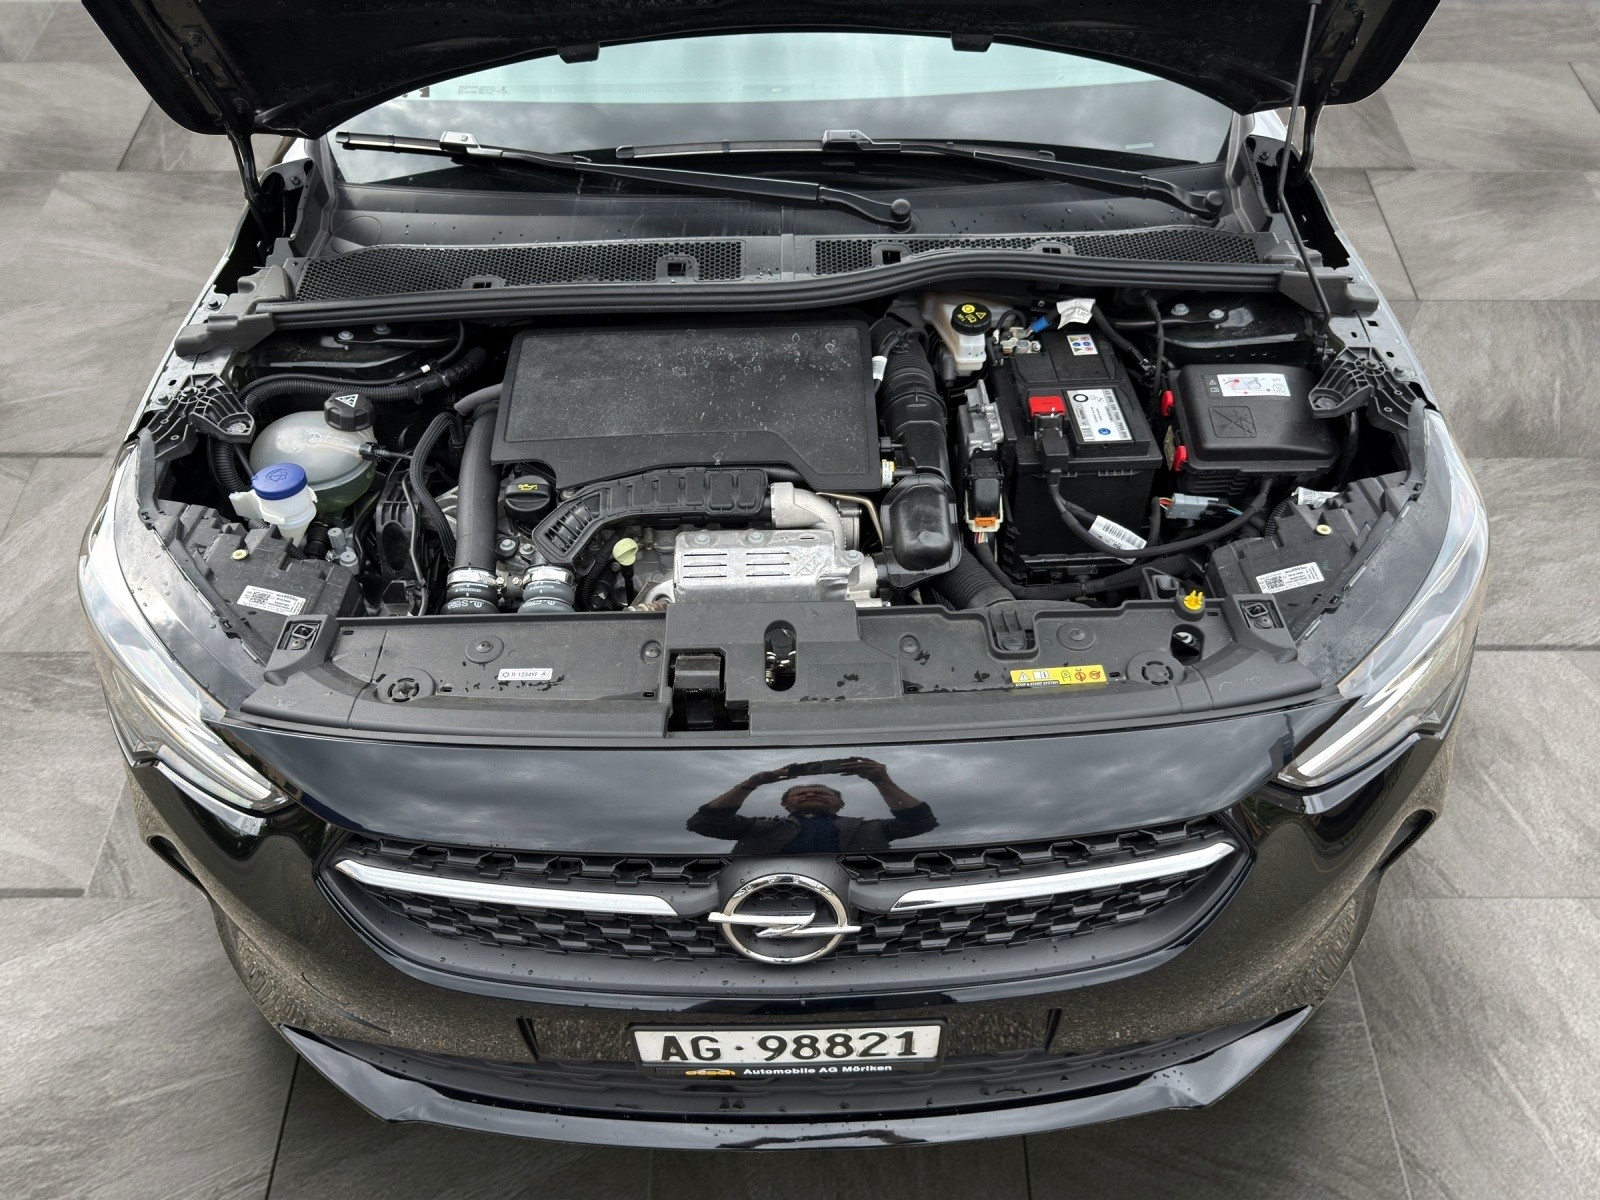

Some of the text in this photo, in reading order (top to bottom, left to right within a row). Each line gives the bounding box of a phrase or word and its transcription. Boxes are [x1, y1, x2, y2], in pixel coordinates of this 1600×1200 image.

[661, 1034, 722, 1061] AG
[757, 1030, 918, 1061] 98821
[743, 1067, 816, 1075] Automobile
[818, 1066, 839, 1074] AG
[842, 1063, 893, 1073] Möriken
